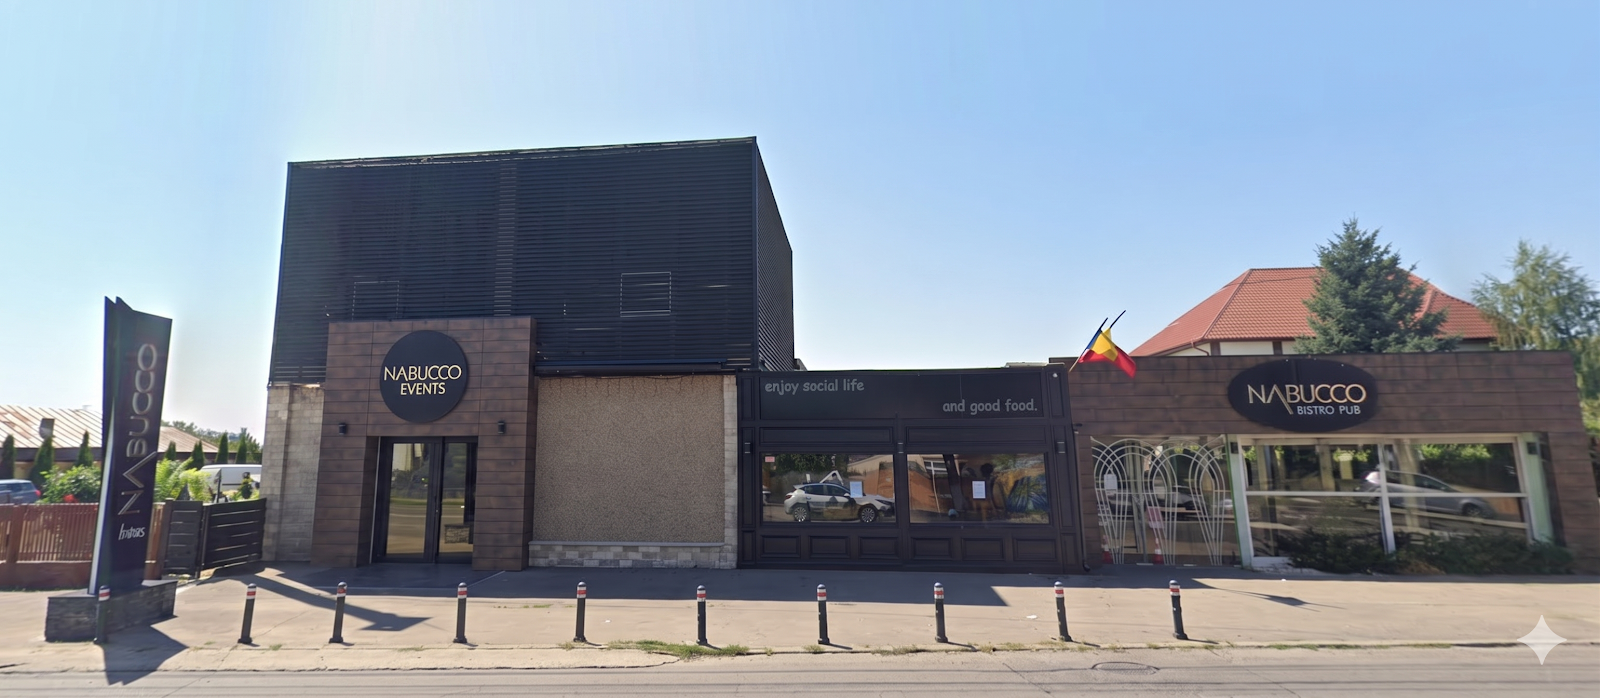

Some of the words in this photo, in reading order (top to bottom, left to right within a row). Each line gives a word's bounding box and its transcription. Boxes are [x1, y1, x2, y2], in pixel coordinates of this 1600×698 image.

[384, 365, 462, 381] NABUCCO
[400, 382, 446, 395] EVENTS
[764, 380, 799, 396] enjoy
[802, 379, 838, 392] social
[843, 378, 865, 391] life
[942, 399, 966, 412] and
[970, 399, 1001, 415] good
[1005, 398, 1038, 412] food.
[1247, 383, 1367, 415] NABUCCO
[1296, 405, 1335, 415] BISTRO
[1339, 405, 1361, 415] PUB
[117, 343, 157, 515] NABUCCO
